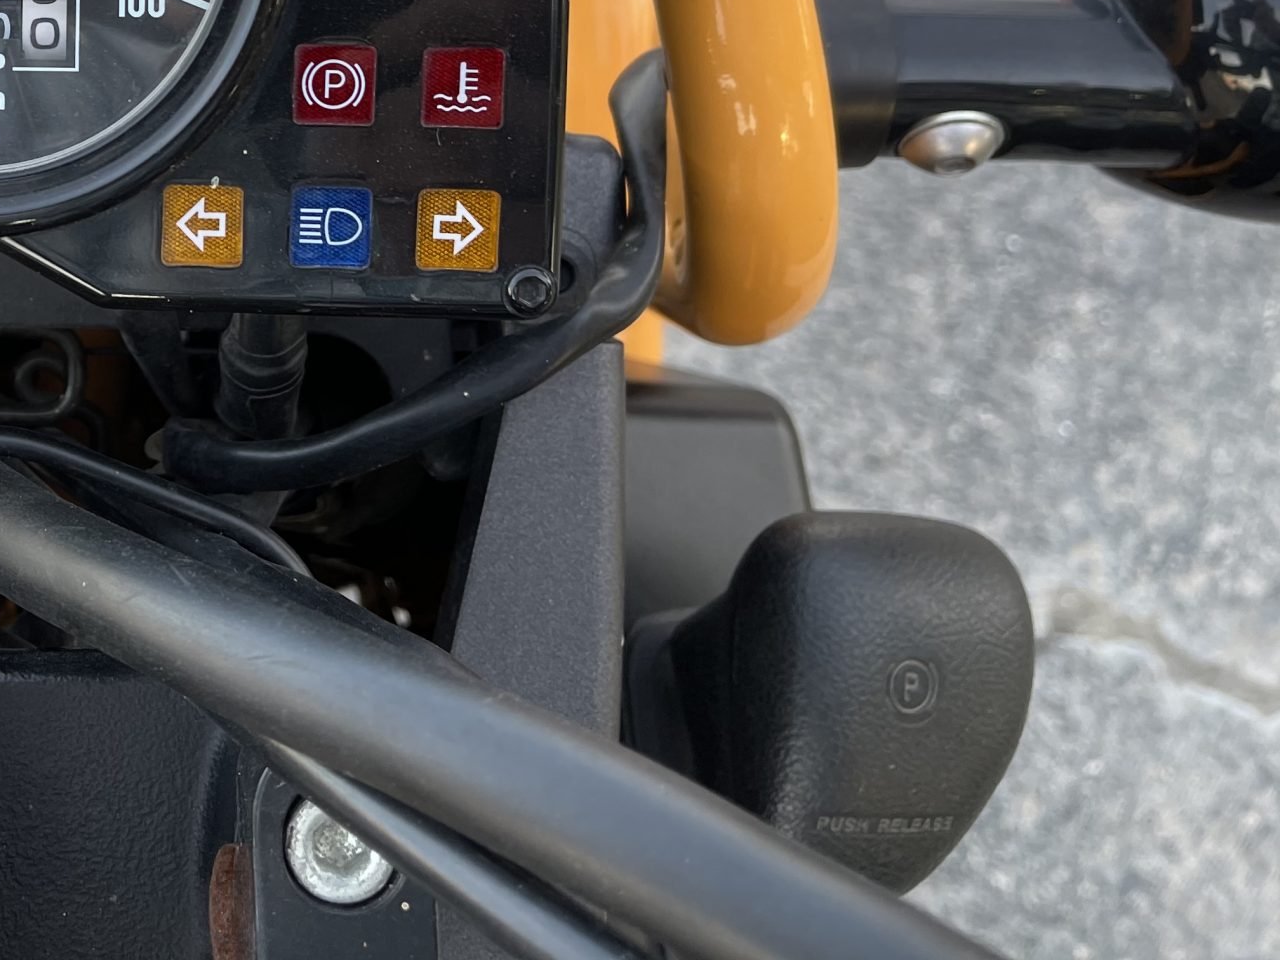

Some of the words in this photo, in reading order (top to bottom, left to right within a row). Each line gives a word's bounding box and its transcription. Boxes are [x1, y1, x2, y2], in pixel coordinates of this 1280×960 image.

[325, 69, 346, 99] P
[904, 672, 919, 701] P
[817, 816, 868, 833] PUSH
[877, 816, 953, 833] RELEASE
